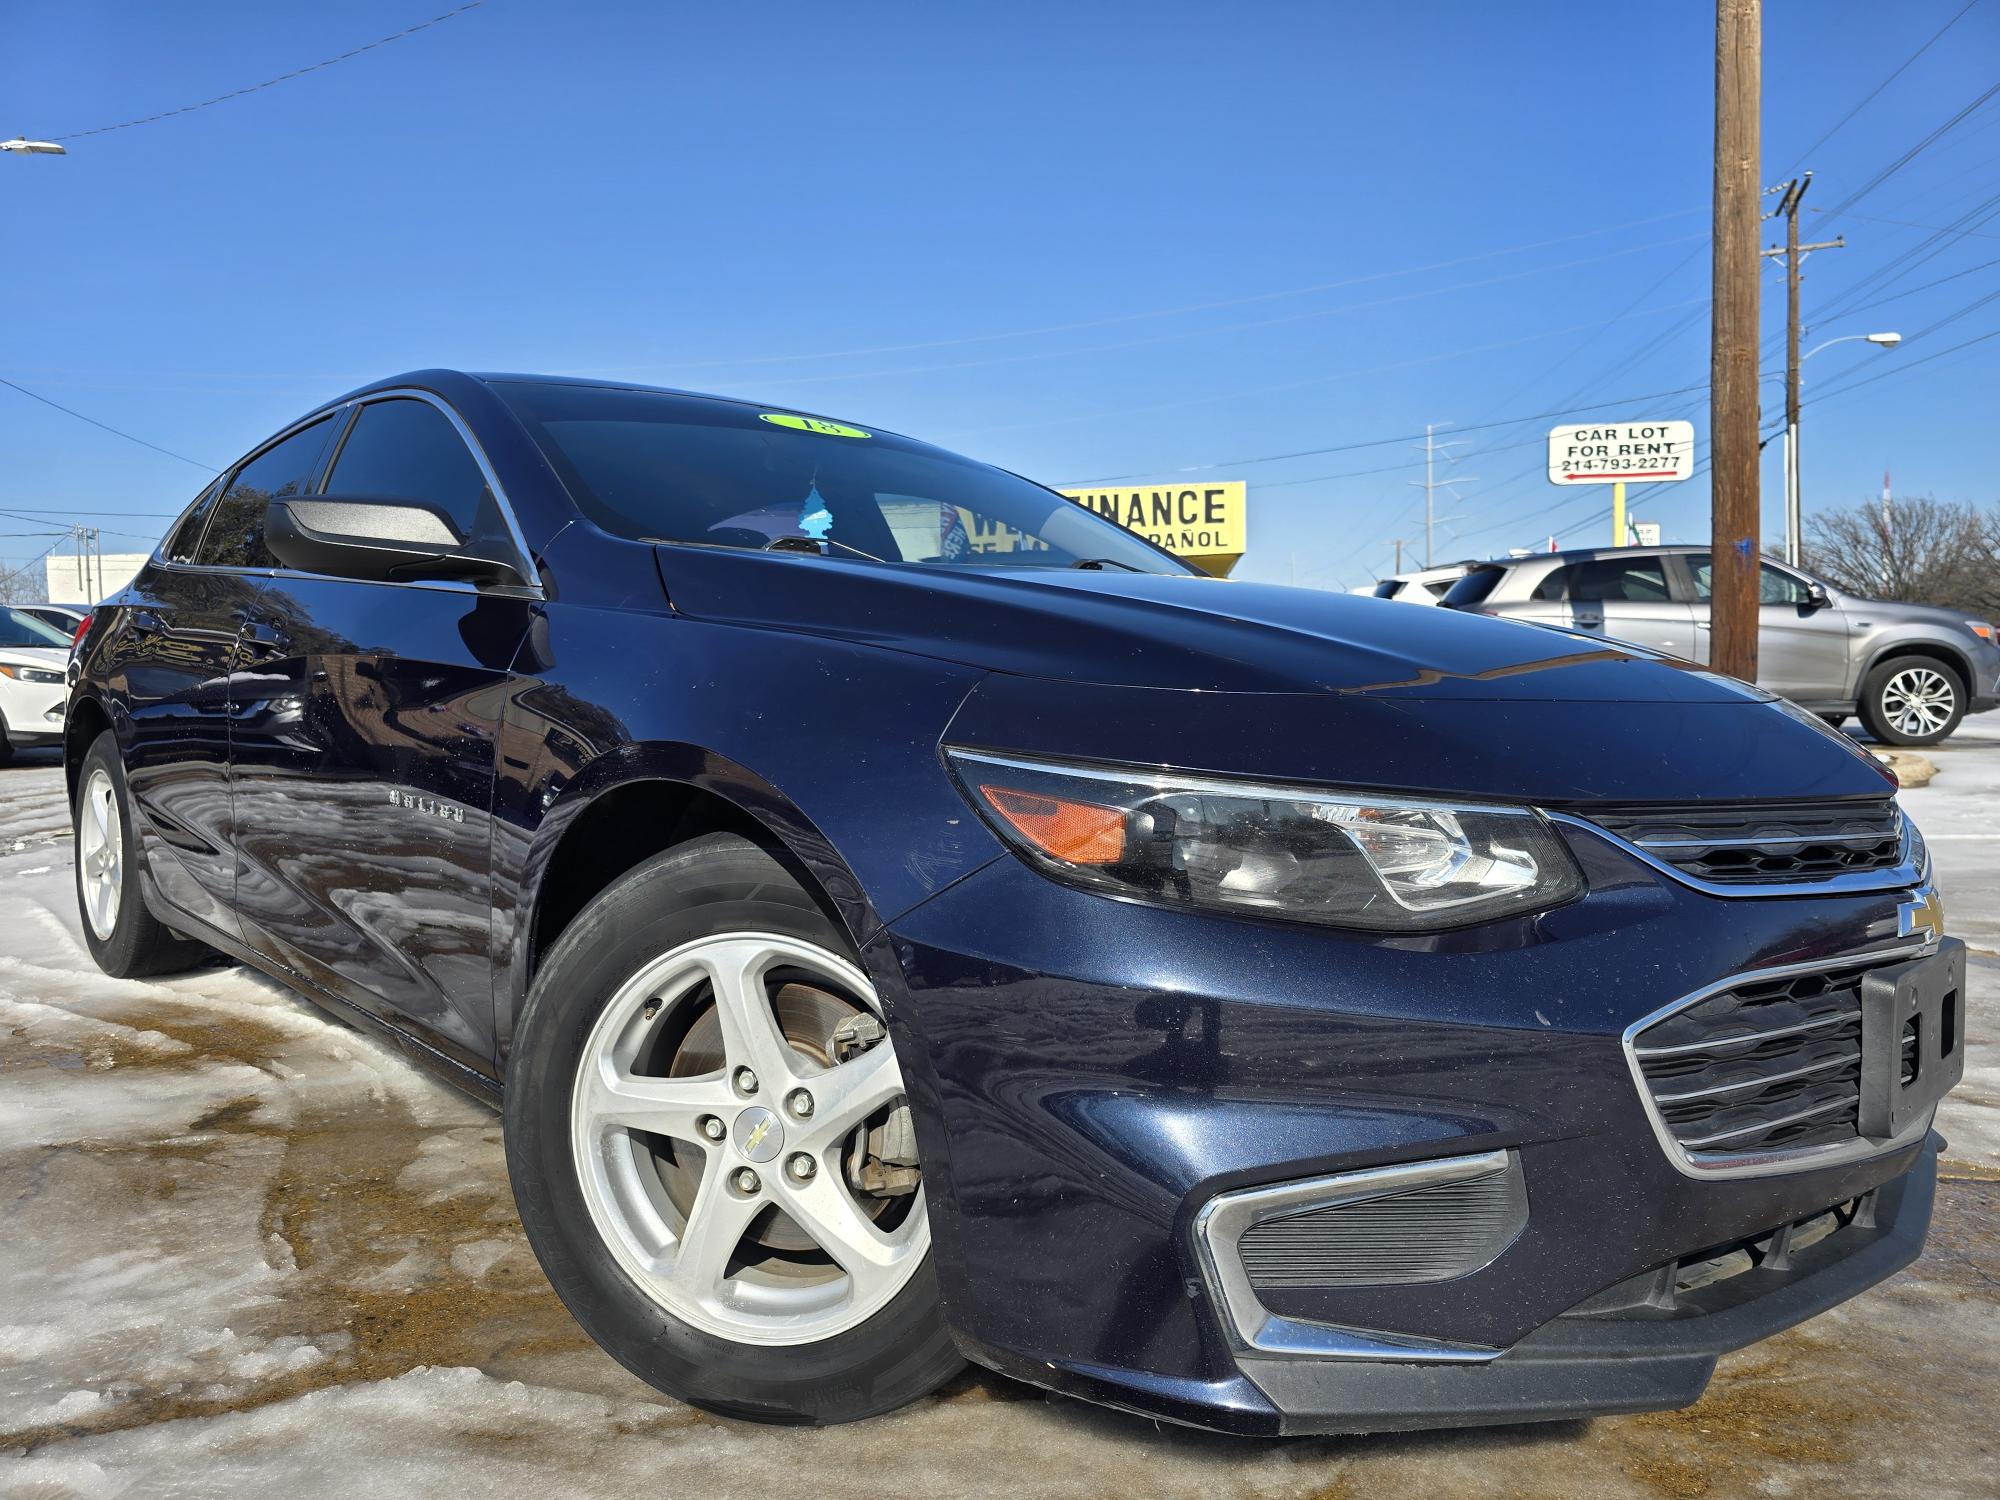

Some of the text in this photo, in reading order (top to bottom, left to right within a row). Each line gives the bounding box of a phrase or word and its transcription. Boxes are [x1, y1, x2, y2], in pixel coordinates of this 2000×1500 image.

[1574, 427, 1669, 441] CAR LOT
[1567, 442, 1675, 457] FOR RENT
[1561, 456, 1680, 471] 214-793-2277
[1068, 489, 1225, 527] NANCE
[389, 789, 464, 823] MALIBU
